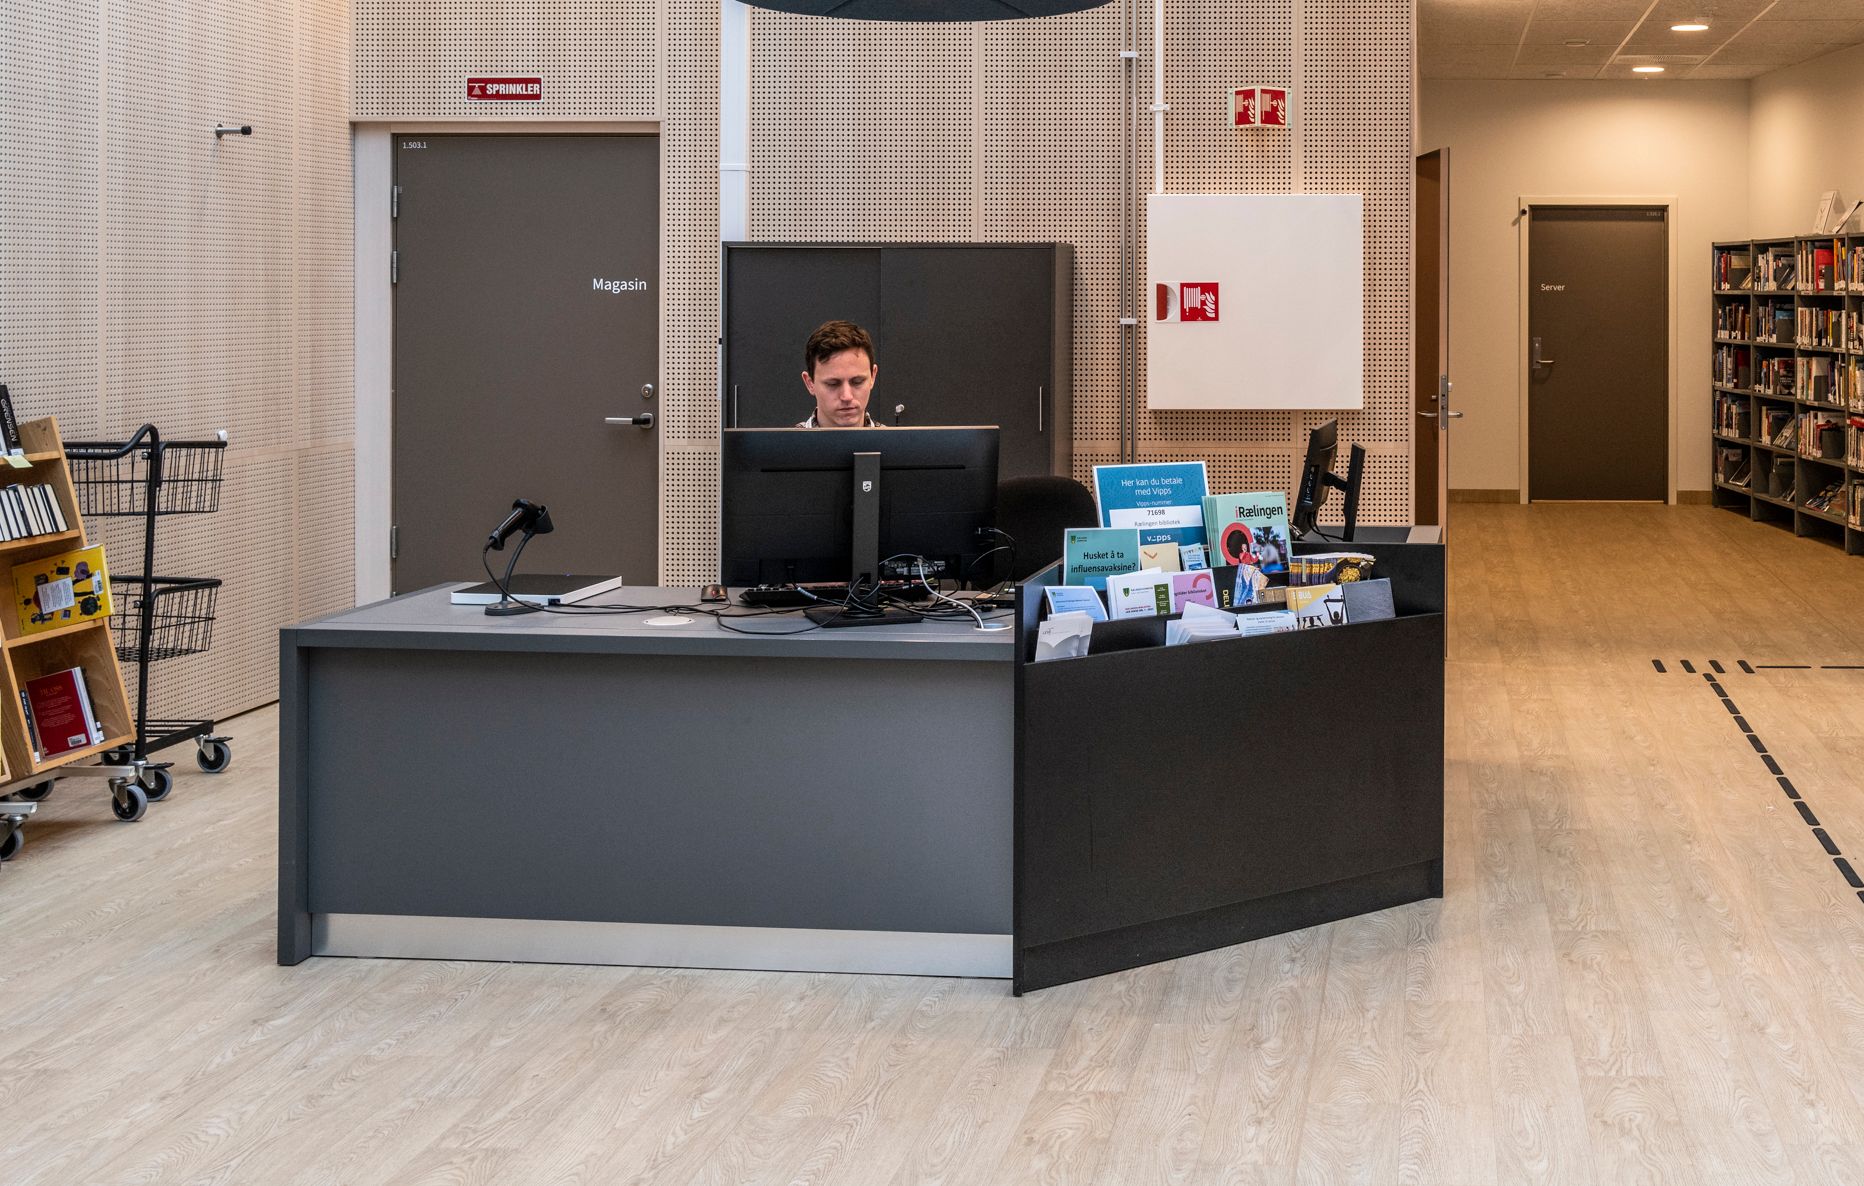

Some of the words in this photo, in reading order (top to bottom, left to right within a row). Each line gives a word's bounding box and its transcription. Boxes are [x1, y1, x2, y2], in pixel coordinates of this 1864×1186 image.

[486, 83, 540, 95] SPRINKLER
[403, 141, 427, 149] 1.503.1
[593, 278, 647, 294] Magasin
[1540, 283, 1566, 291] Server
[1121, 479, 1134, 487] Her
[1135, 478, 1149, 486] kan
[1150, 478, 1160, 486] du
[1161, 477, 1183, 485] betale
[1135, 488, 1151, 496] med
[1153, 487, 1172, 496] Vipps
[1235, 504, 1283, 519] iRælingen
[1083, 551, 1109, 560] Husket
[1110, 550, 1115, 559] å
[1116, 551, 1125, 559] ta
[1071, 562, 1136, 573] influensavaksine?
